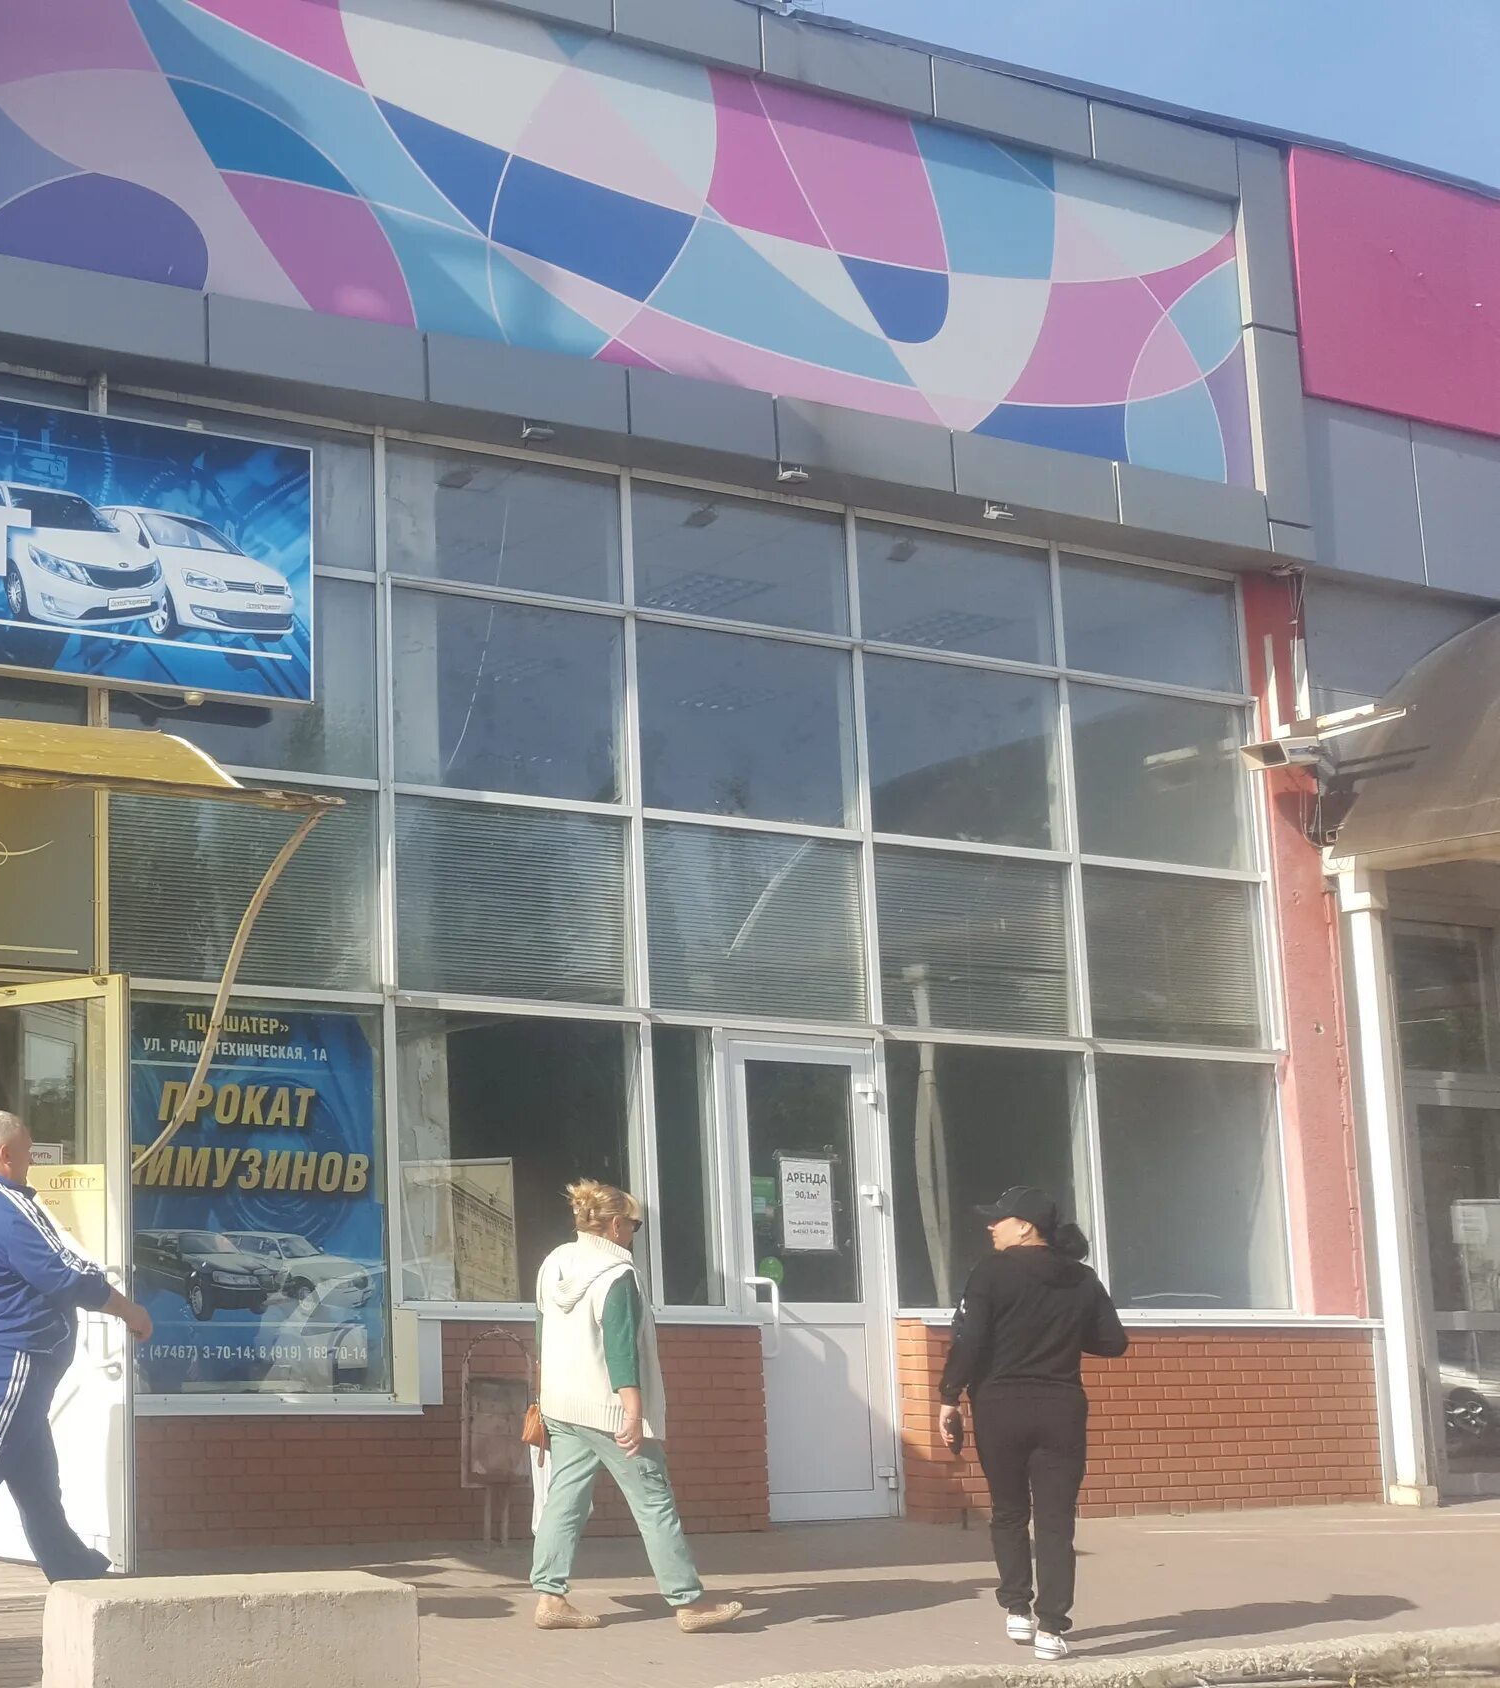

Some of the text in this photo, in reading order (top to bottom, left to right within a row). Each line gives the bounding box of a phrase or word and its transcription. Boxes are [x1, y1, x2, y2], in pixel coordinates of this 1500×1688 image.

[186, 1012, 289, 1036] ТЦ ШАТЕР»
[143, 1038, 327, 1062] УЛ. РАДИТЕХНИЧЕСКАЯ, 1А
[157, 1080, 316, 1127] ПРОКАТ
[786, 1172, 827, 1186] АРЕНДА
[150, 1345, 198, 1361] (47467)
[259, 1346, 266, 1359] 8
